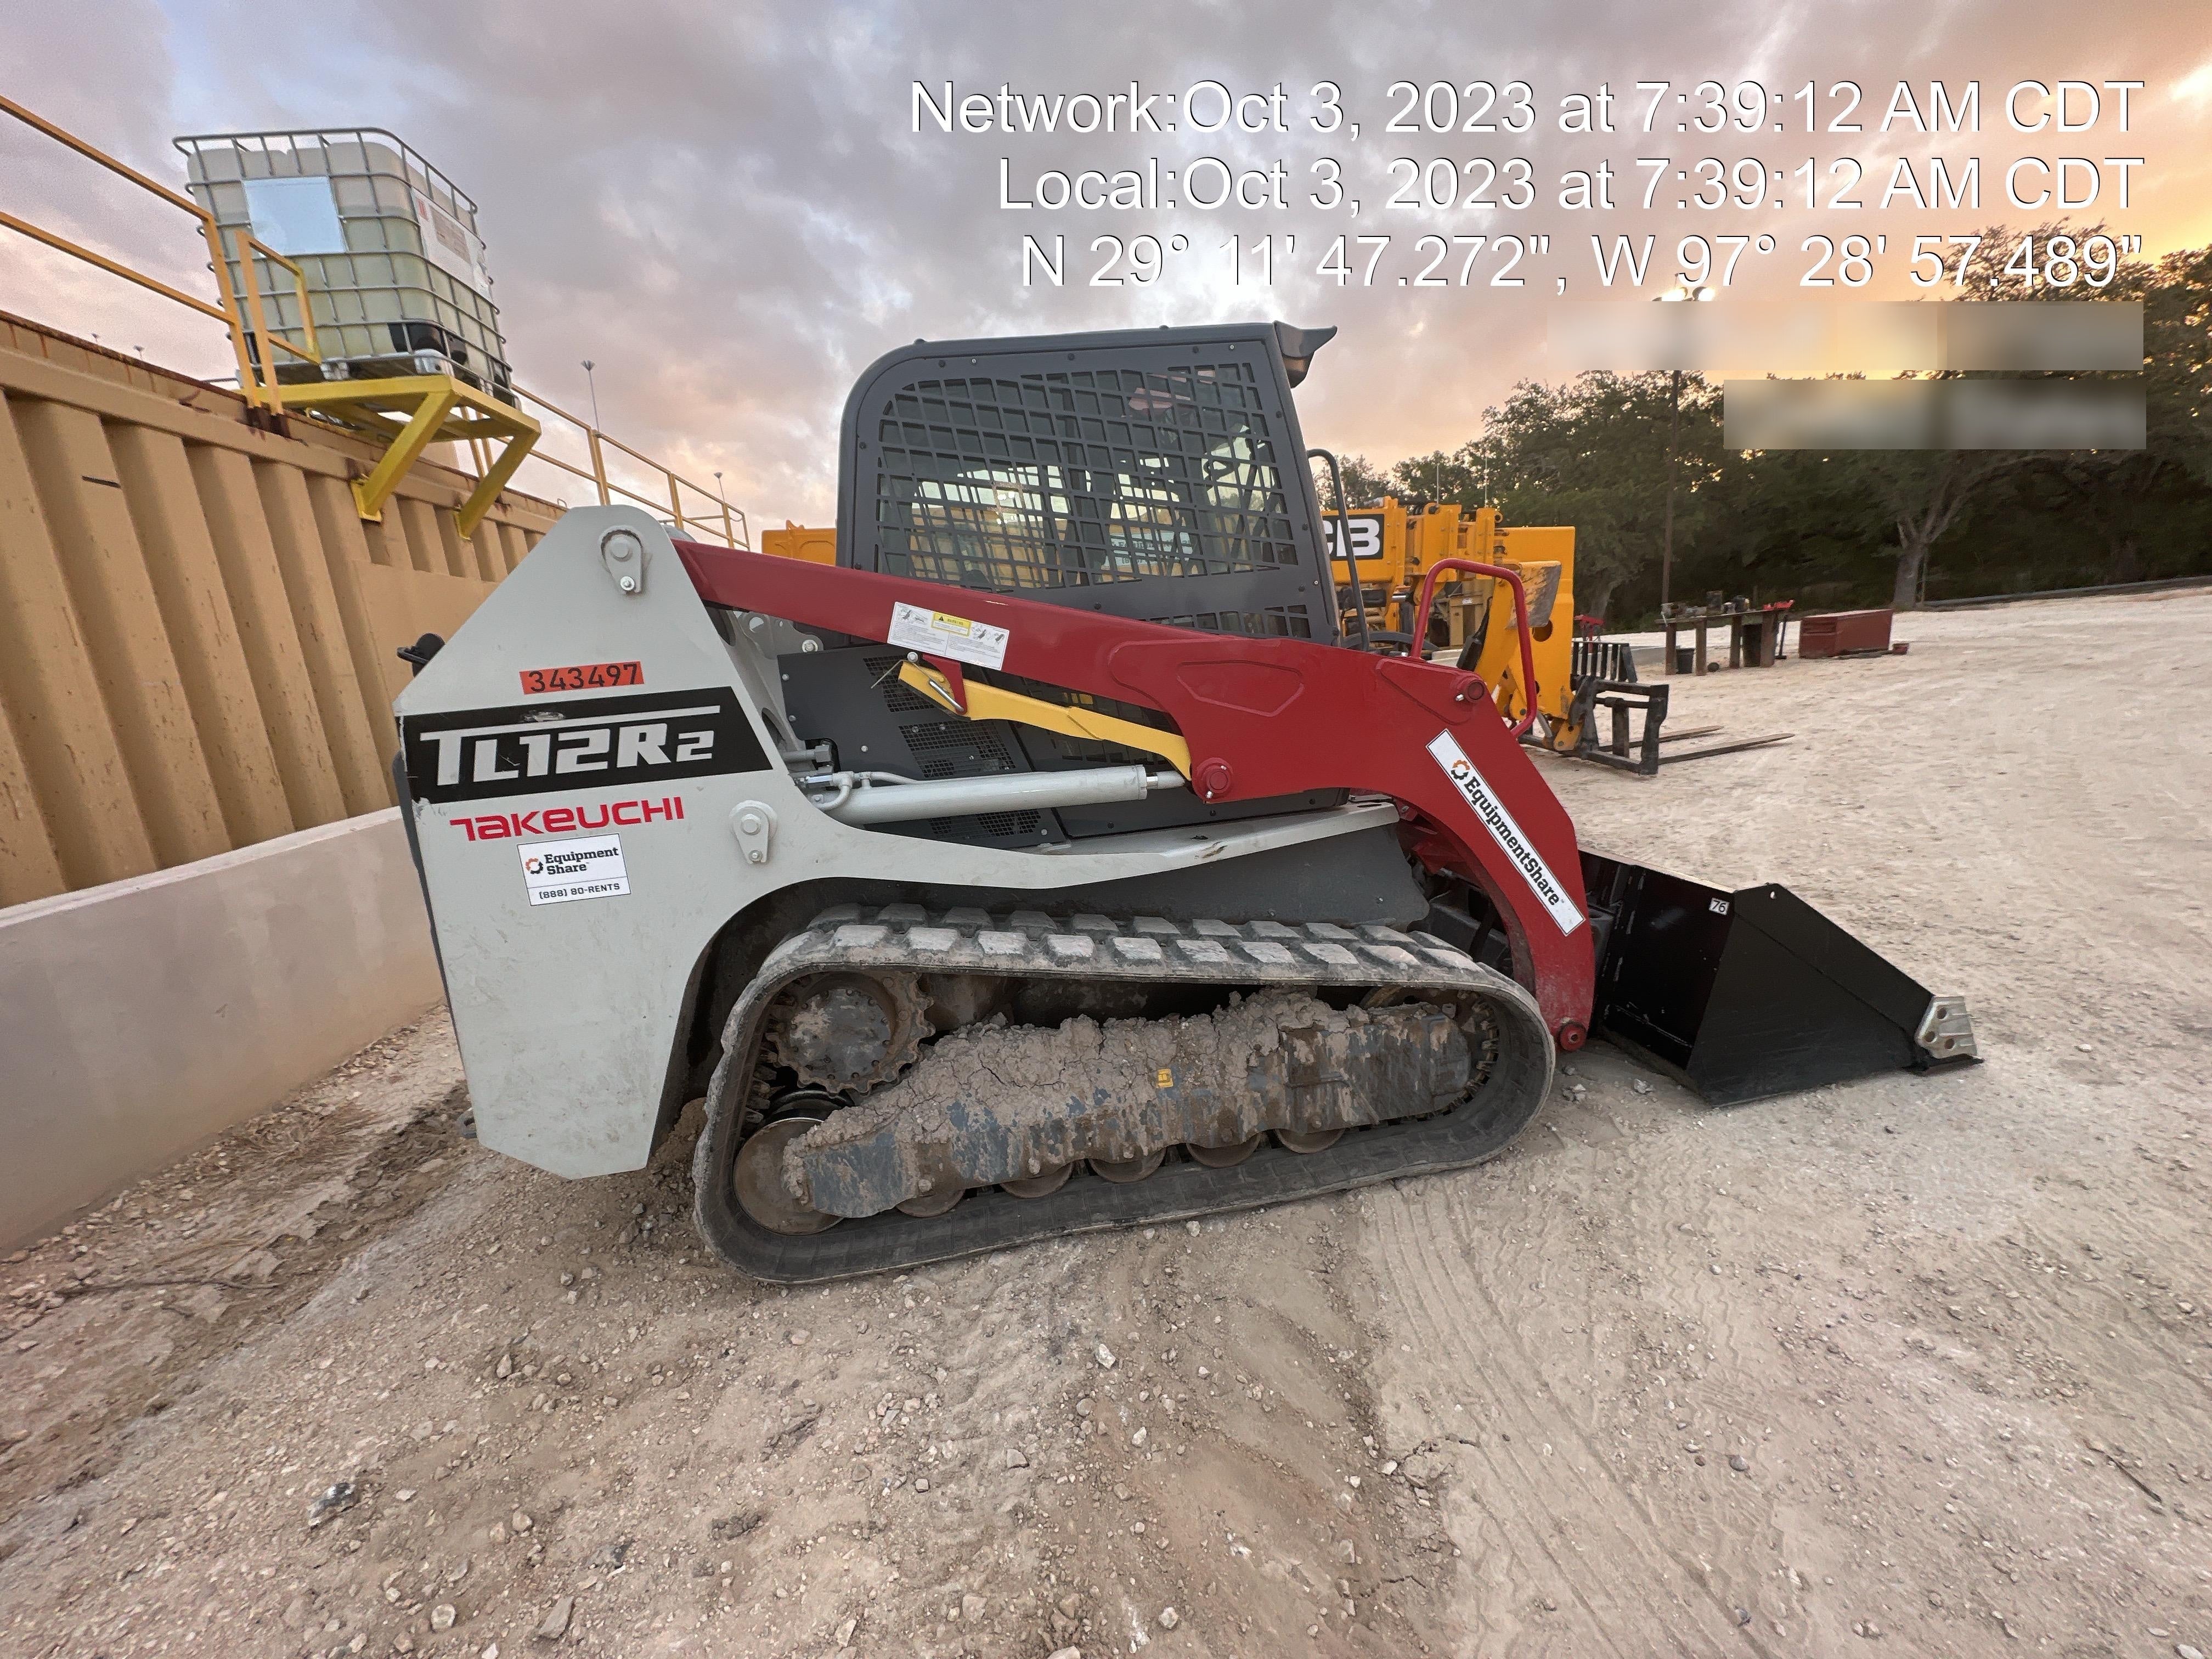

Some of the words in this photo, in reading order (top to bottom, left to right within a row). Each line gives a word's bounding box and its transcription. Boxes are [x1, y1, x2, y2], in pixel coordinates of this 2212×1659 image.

[528, 662, 640, 692] 343497
[1464, 776, 1560, 906] EquipmentShare
[544, 847, 619, 864] Equipment
[539, 889, 567, 900] (888)
[571, 883, 620, 895] 80-RENTS
[1713, 900, 1726, 912] 76
